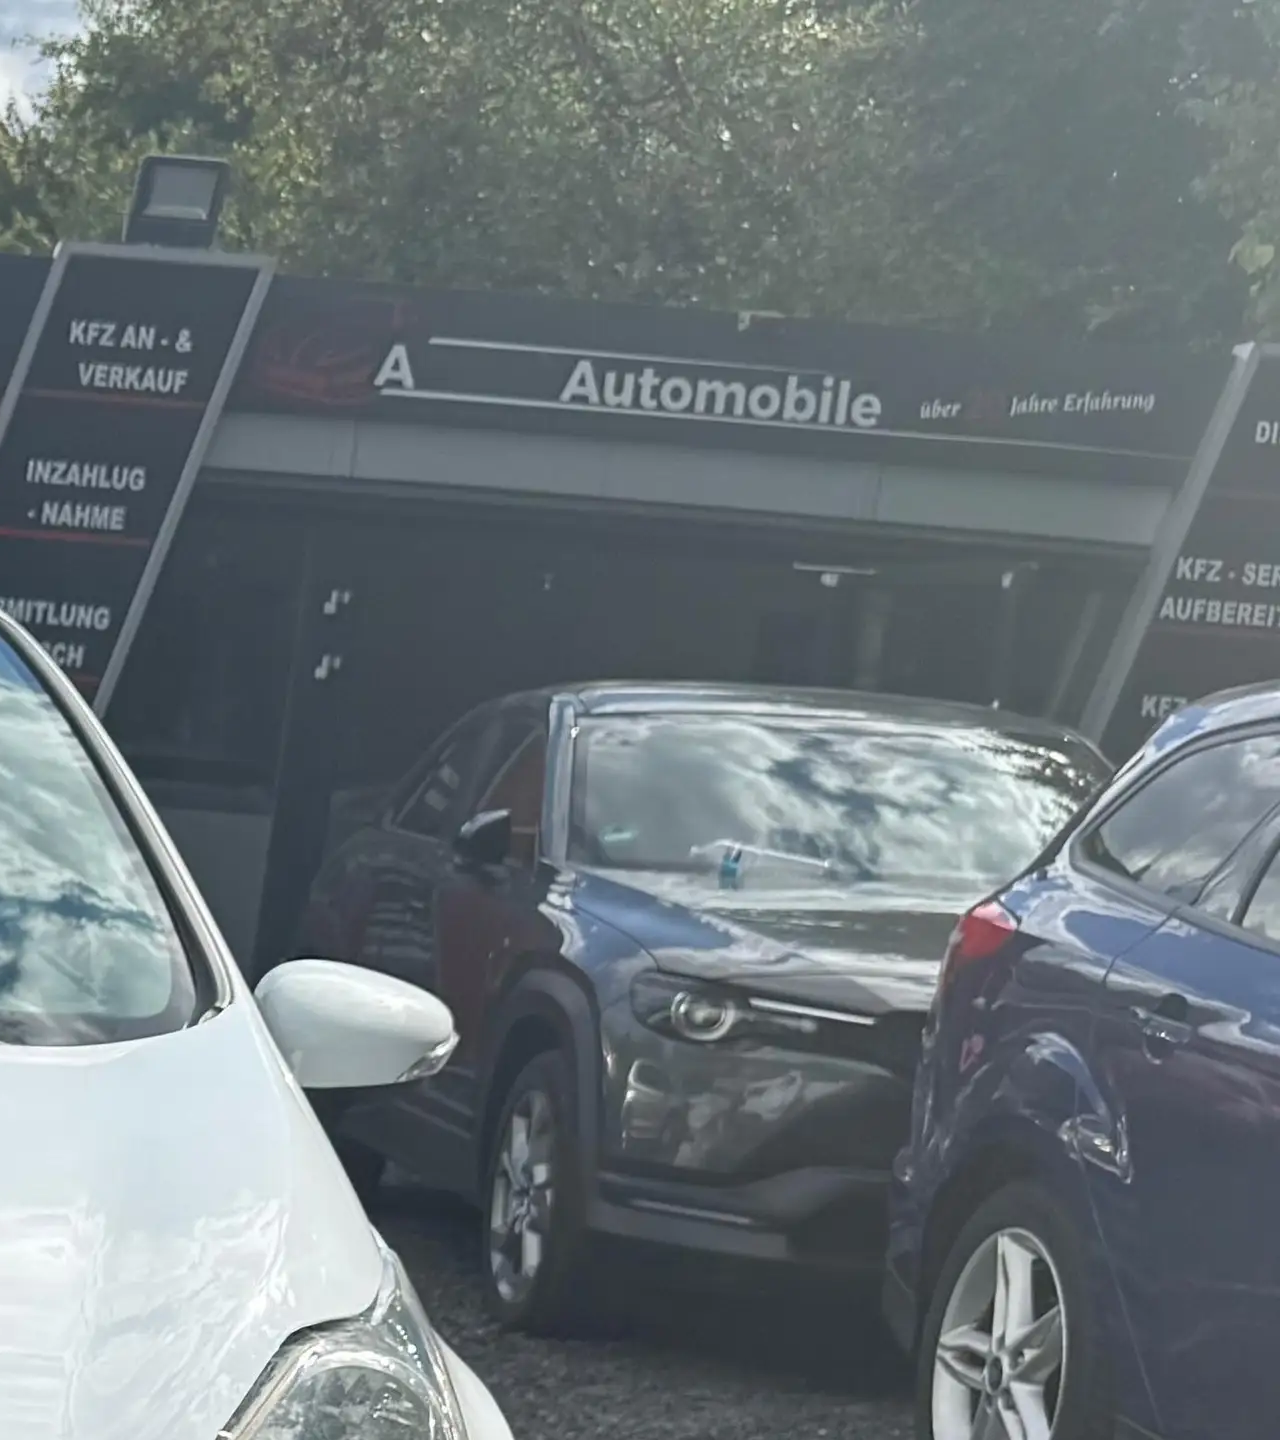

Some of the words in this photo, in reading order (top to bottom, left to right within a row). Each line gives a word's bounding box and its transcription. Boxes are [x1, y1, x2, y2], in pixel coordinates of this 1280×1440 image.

[69, 319, 115, 348] KFZ
[120, 323, 156, 351] AN
[175, 329, 192, 353] &
[78, 362, 189, 394] VERKAUF
[374, 344, 415, 389] A
[559, 359, 882, 428] Automobile
[920, 399, 961, 420] über
[1010, 394, 1058, 417] Jahre
[1063, 390, 1156, 417] Erfahrung
[26, 458, 146, 491] INZAHLUG
[41, 501, 127, 531] NAHME
[1176, 556, 1223, 583] KFZ
